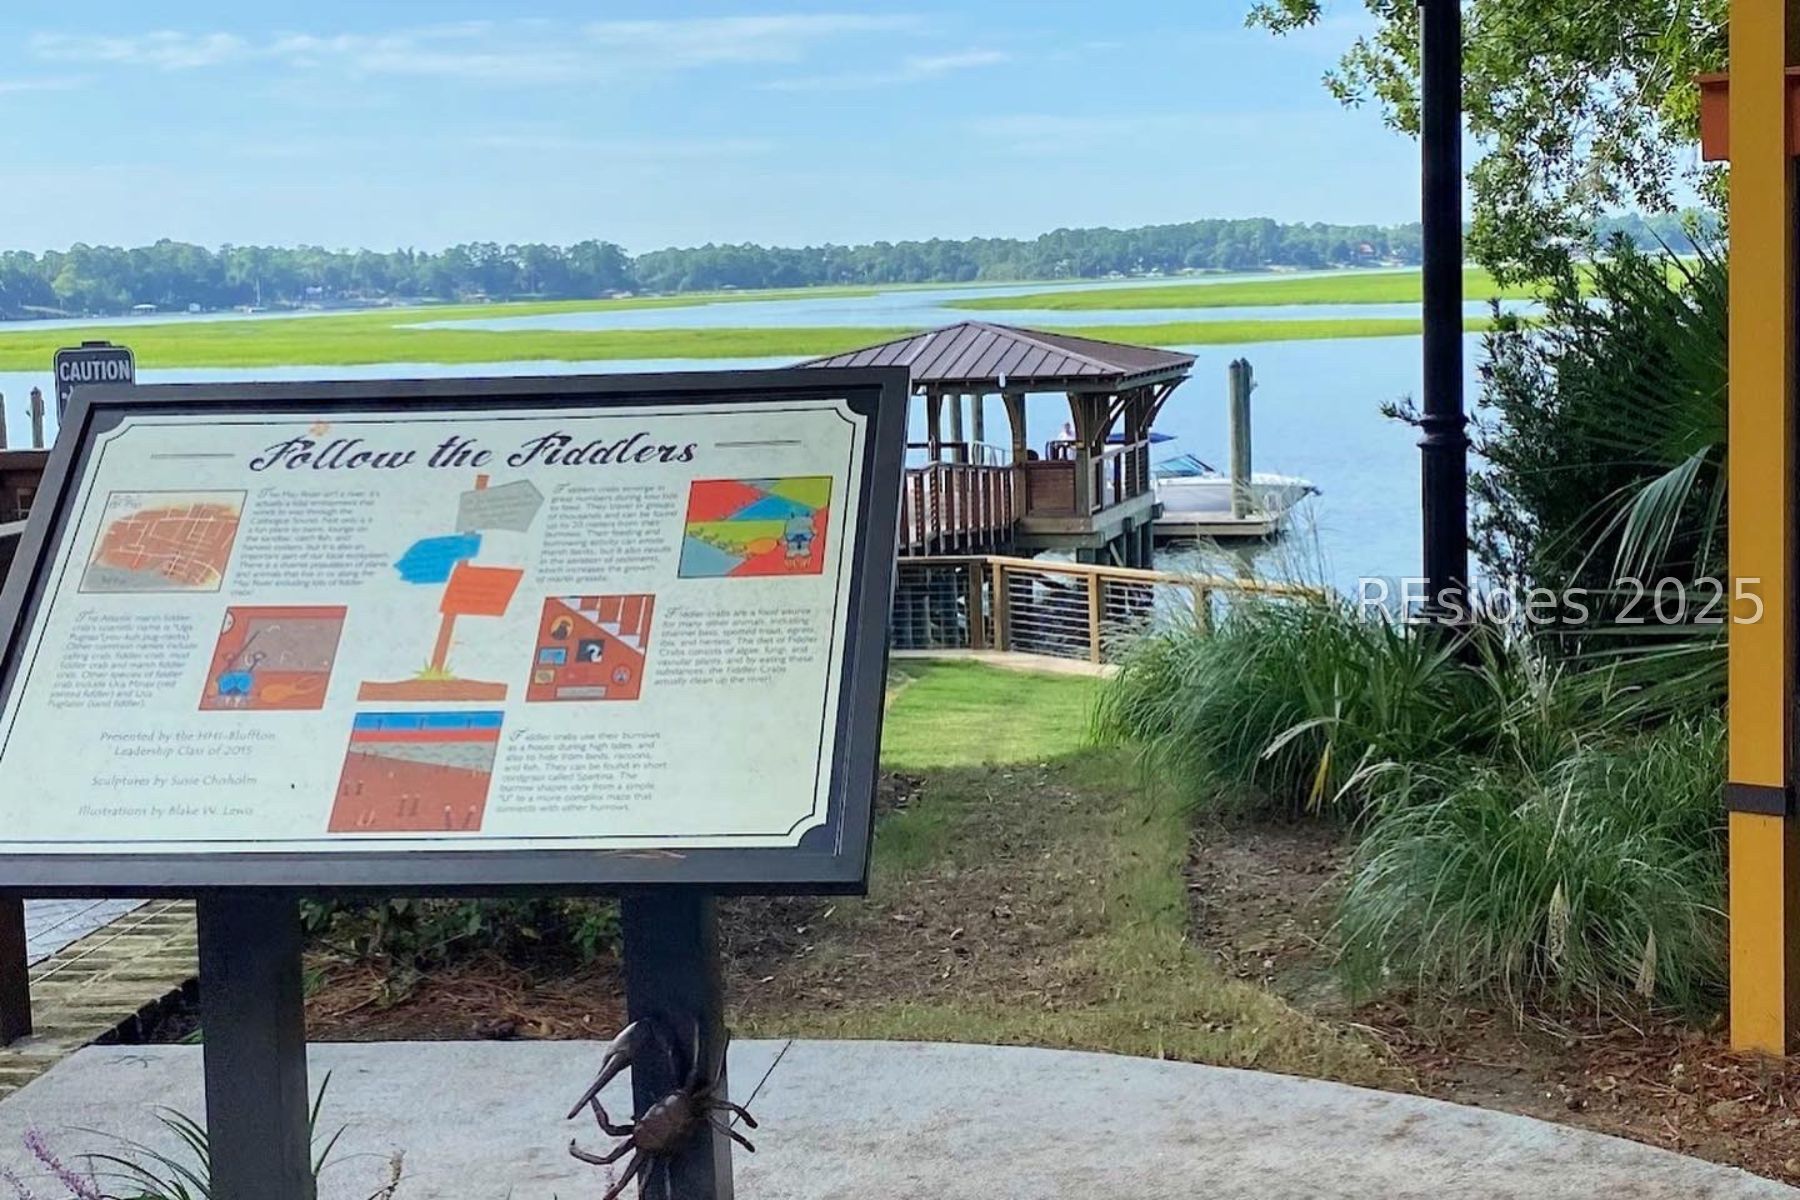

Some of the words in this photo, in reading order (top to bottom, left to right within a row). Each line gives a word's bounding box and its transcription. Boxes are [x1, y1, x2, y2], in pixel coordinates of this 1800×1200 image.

[60, 360, 130, 381] CAUTION
[250, 435, 416, 471] Follow
[427, 435, 492, 468] the
[507, 430, 698, 468] Fiddlers
[99, 731, 154, 742] Presented
[158, 730, 172, 744] by
[176, 730, 194, 741] the
[114, 744, 175, 758] Leadership
[177, 745, 204, 756] Class
[207, 744, 223, 757] of
[222, 745, 254, 756] 2015
[91, 774, 150, 790] Sculptures
[152, 773, 167, 788] by
[79, 803, 148, 817] Illustrations
[151, 803, 166, 819] by
